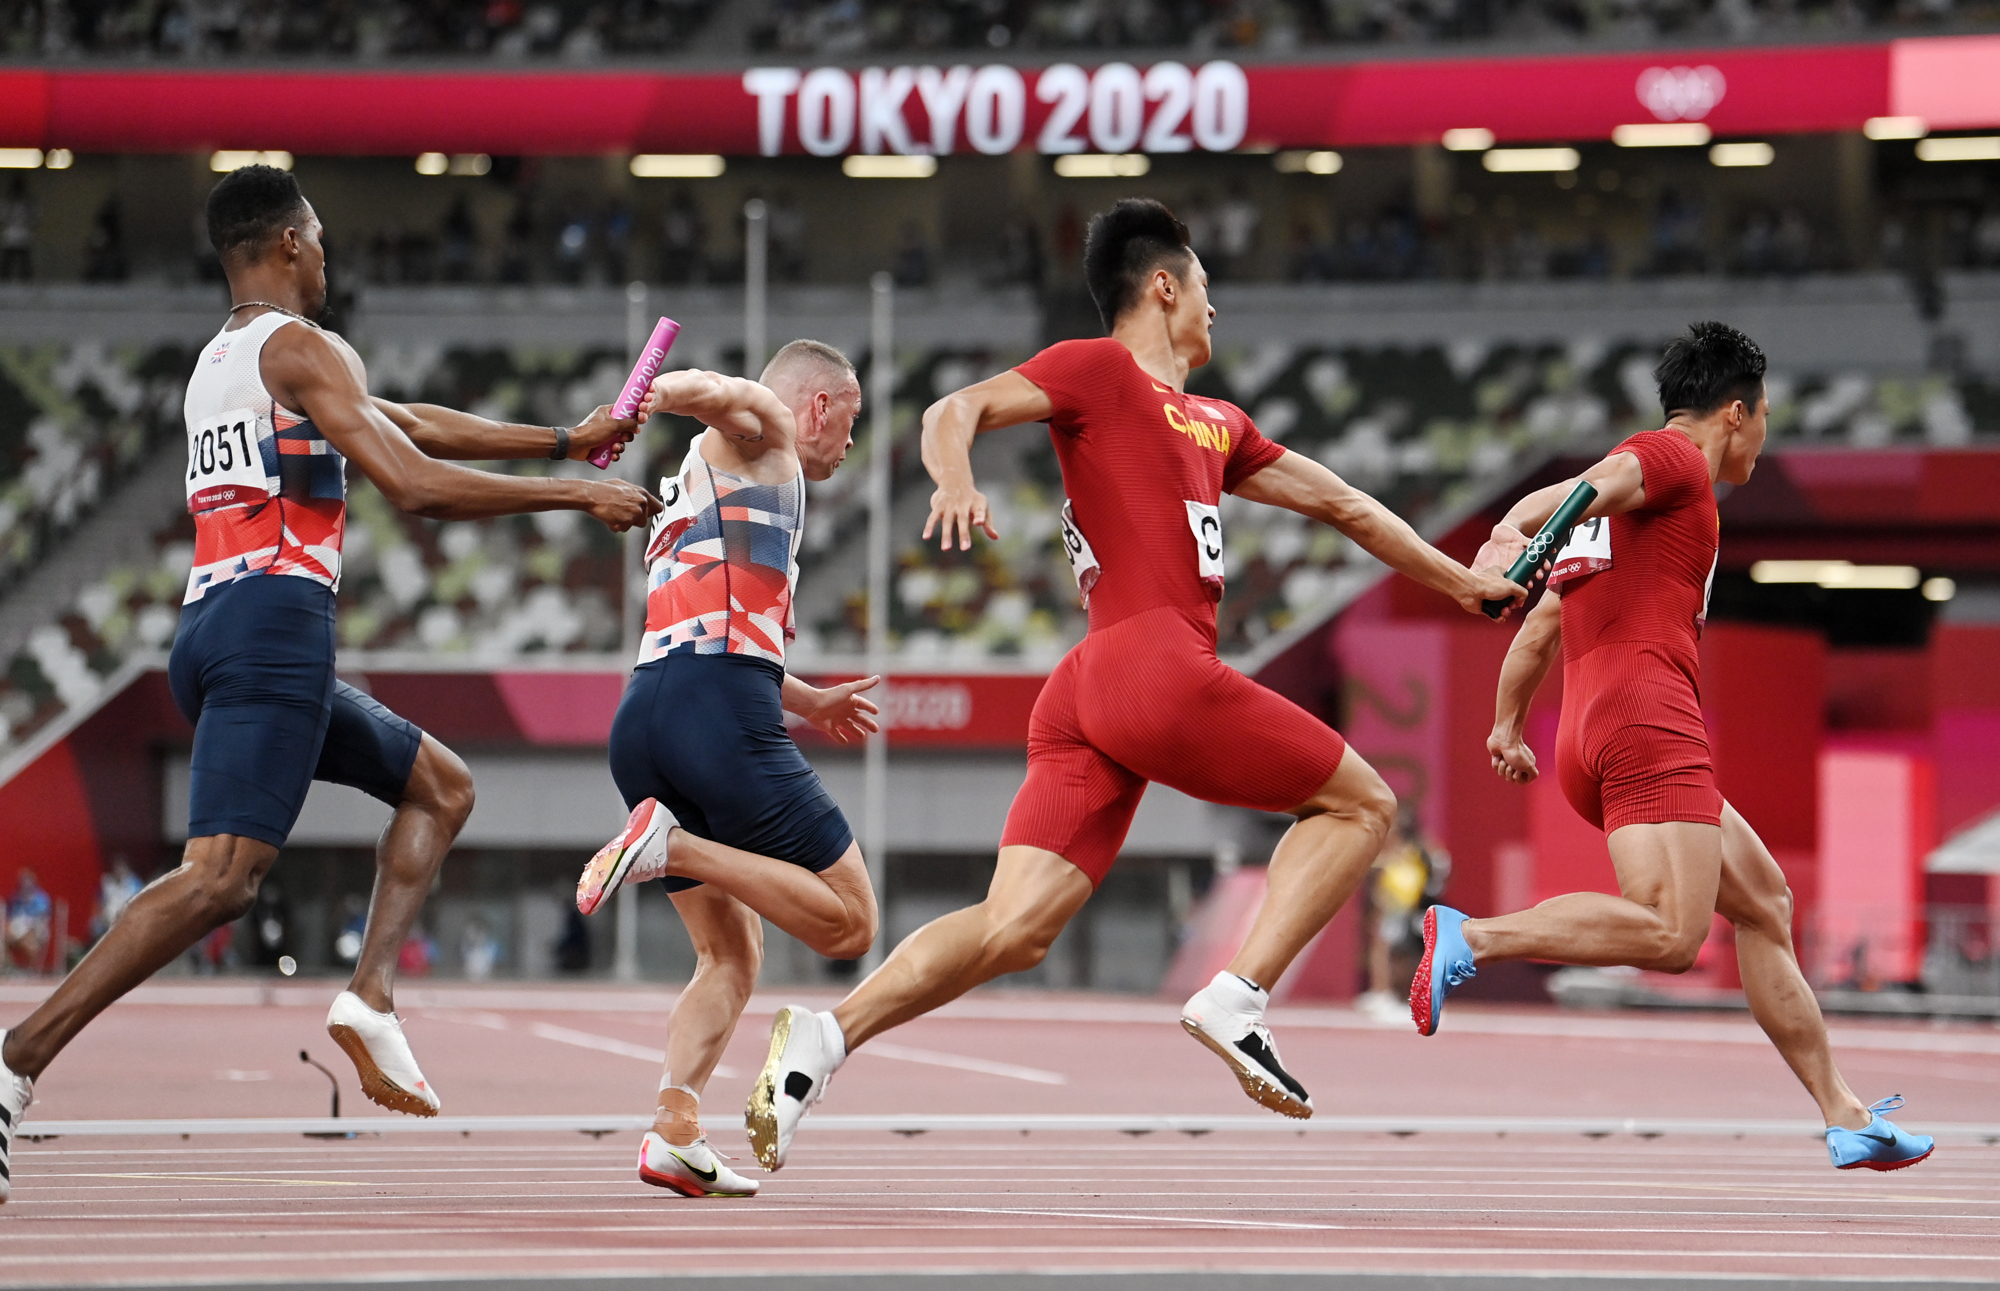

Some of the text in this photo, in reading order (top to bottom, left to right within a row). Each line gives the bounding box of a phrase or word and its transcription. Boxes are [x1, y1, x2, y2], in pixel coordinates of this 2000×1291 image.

[742, 59, 1249, 157] TOKYO 2020
[637, 346, 665, 388] 2020
[189, 421, 252, 481] 2051
[1163, 402, 1231, 457] CHINA
[198, 495, 212, 504] TOKYO
